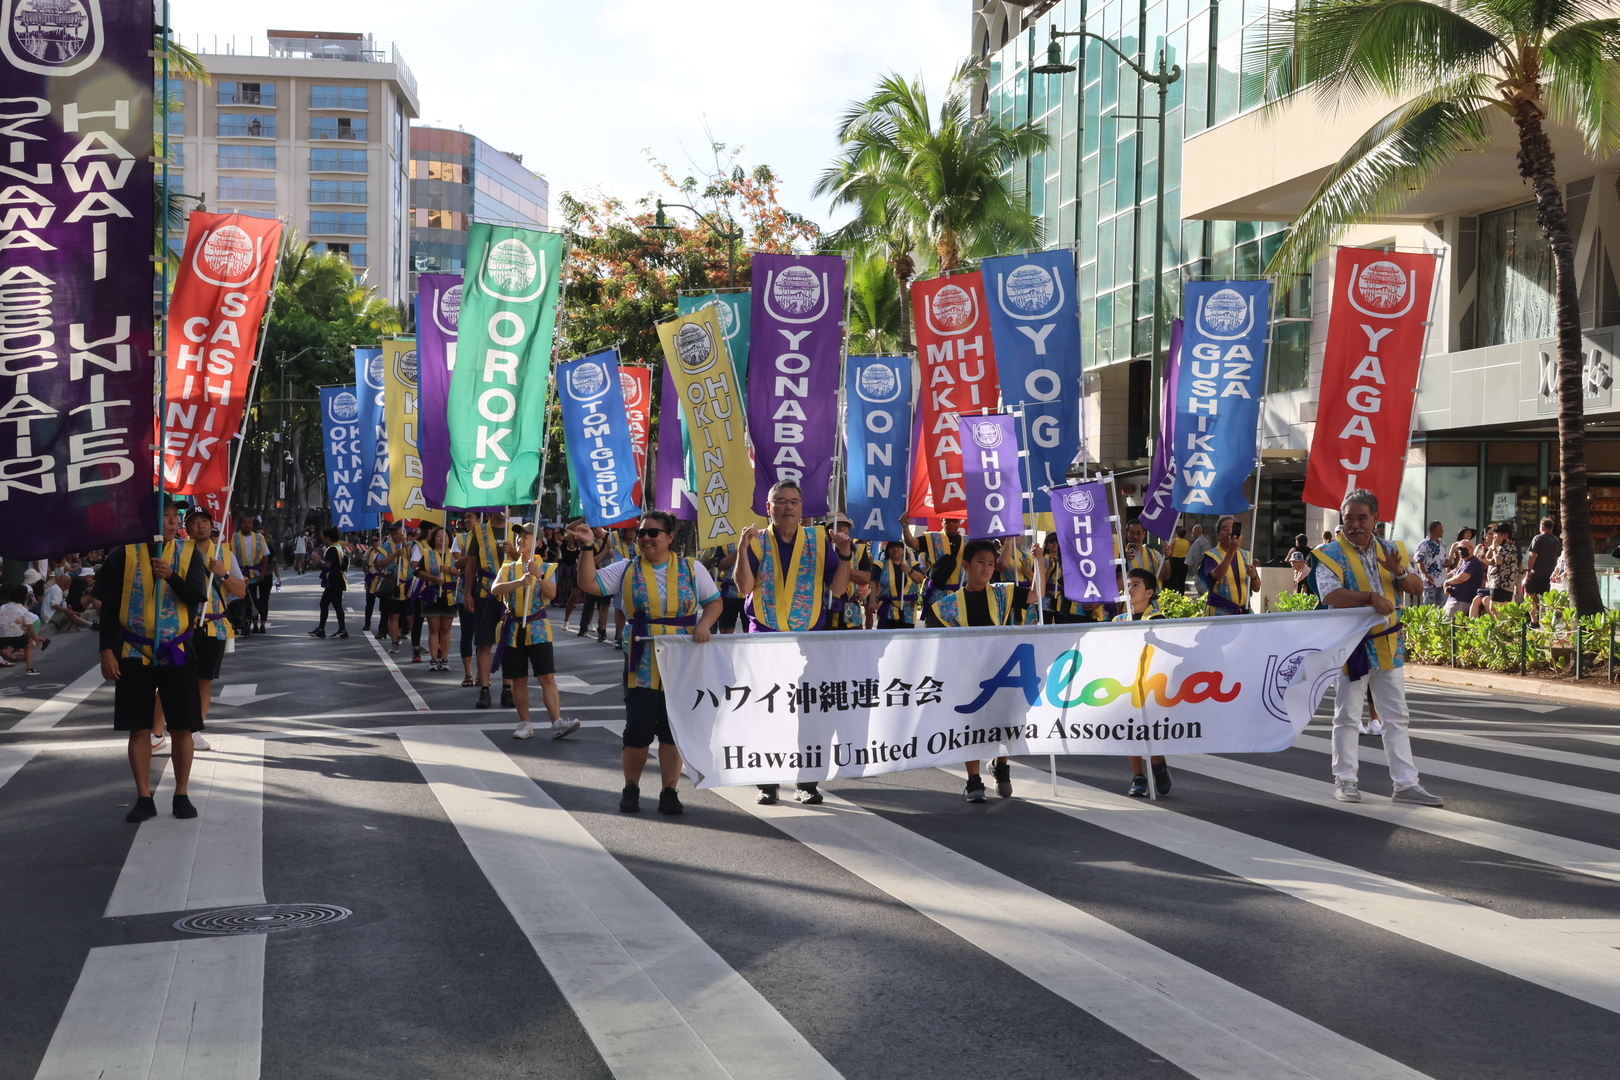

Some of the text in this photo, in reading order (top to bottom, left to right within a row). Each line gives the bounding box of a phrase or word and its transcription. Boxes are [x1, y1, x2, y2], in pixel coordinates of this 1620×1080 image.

[61, 100, 136, 492] HAWAII UNITED
[187, 292, 249, 486] SASHIKI
[472, 311, 526, 490] OROKU
[704, 372, 733, 441] HUI
[772, 329, 813, 488] YONABAR
[926, 340, 966, 503] MAKAALA
[957, 335, 985, 405] HUI
[1016, 324, 1061, 488] YOGI
[1182, 342, 1222, 506] GUSHIKAWA
[1220, 344, 1254, 399] GAZA
[330, 426, 354, 528] OKINAWA
[582, 400, 621, 519] TOMIGUSUKU
[687, 382, 737, 540] OKINAWA
[863, 410, 893, 531] ONNA
[980, 451, 1006, 534] HUOA
[1073, 515, 1102, 599] HUOA
[691, 675, 945, 714] ハワイ沖縄連合会
[954, 643, 1242, 714] Aloha
[722, 716, 1203, 771] Hawaii United Okinawa Association
